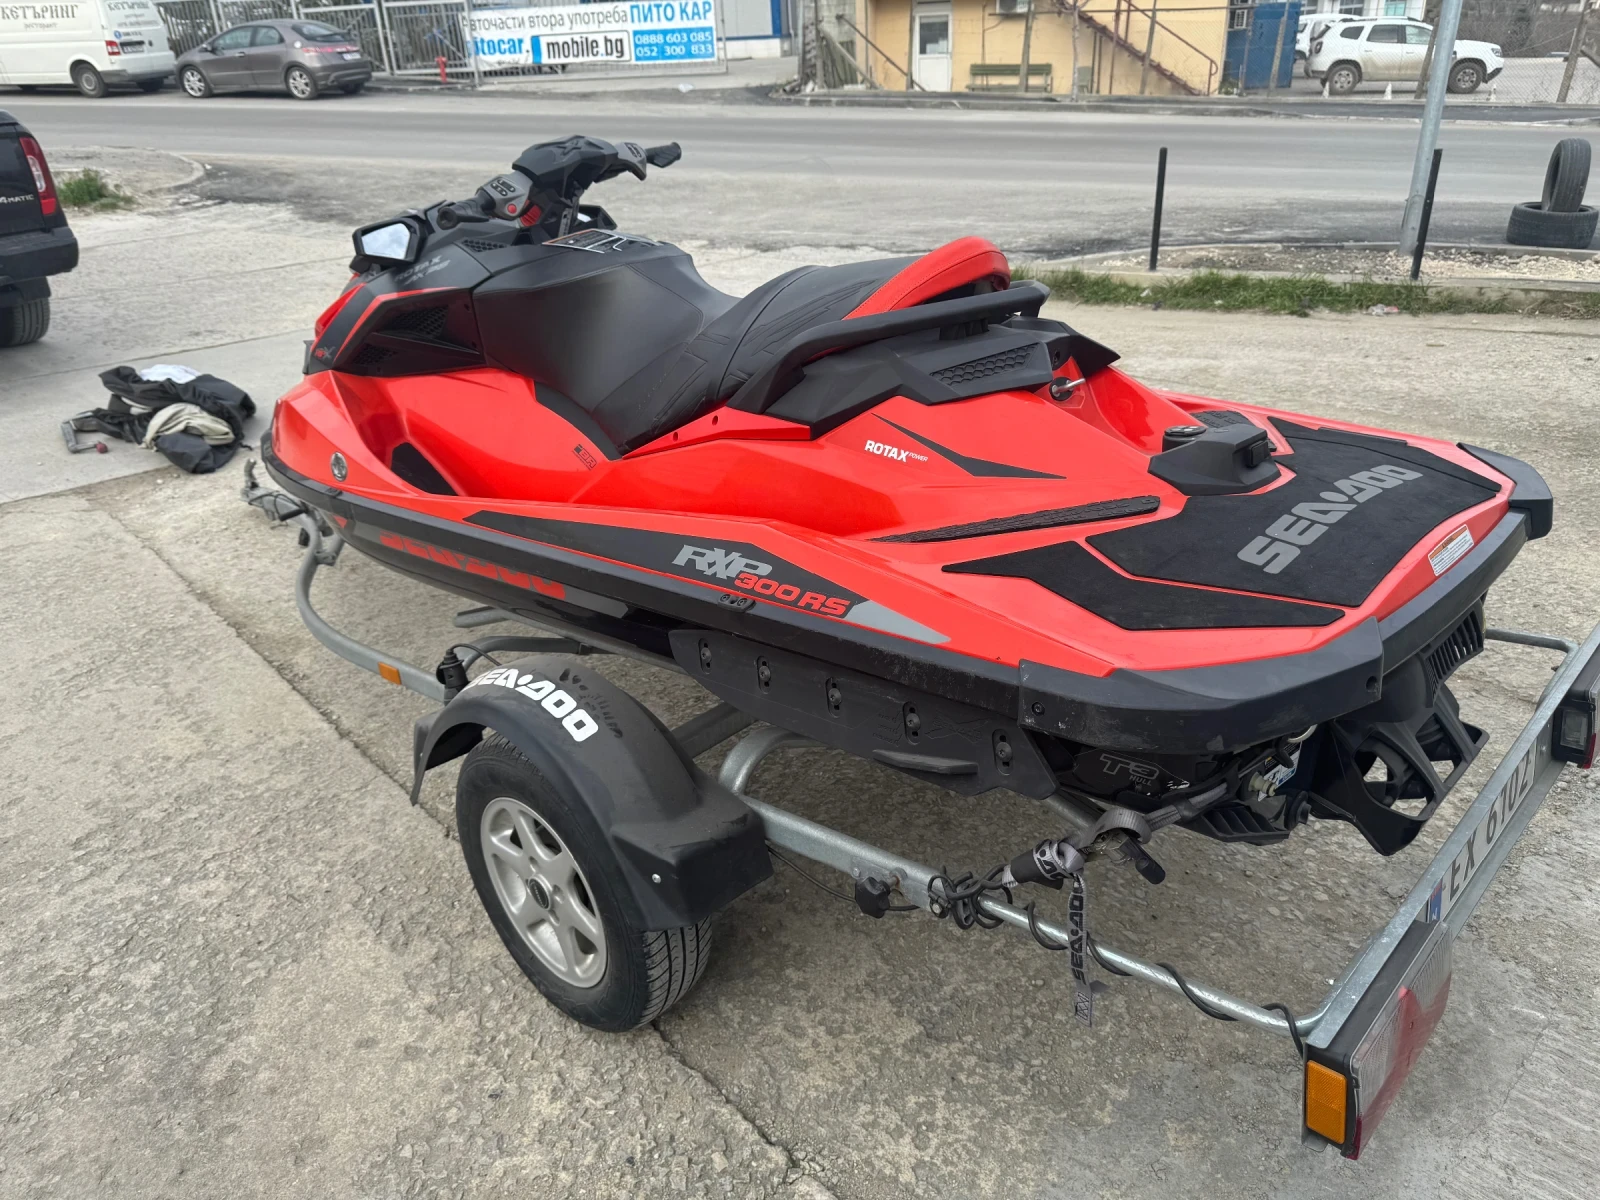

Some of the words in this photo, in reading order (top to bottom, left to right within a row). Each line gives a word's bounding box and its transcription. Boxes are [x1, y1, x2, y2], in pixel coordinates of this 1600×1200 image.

[528, 13, 564, 30] втора
[567, 5, 628, 30] употреба
[630, 3, 675, 23] ПИТО
[680, 1, 712, 20] КАР
[547, 35, 624, 58] mobile.bg
[635, 34, 664, 45] 0888
[665, 33, 688, 43] 603
[690, 31, 712, 42] 085
[636, 46, 658, 57] 052
[664, 45, 685, 56] 300
[691, 43, 713, 54] 833
[864, 440, 909, 462] ROTAX
[908, 452, 929, 462] POWER
[672, 544, 772, 580] RXP
[734, 573, 800, 602] 300
[797, 591, 851, 616] RS
[1129, 775, 1153, 787] HULL
